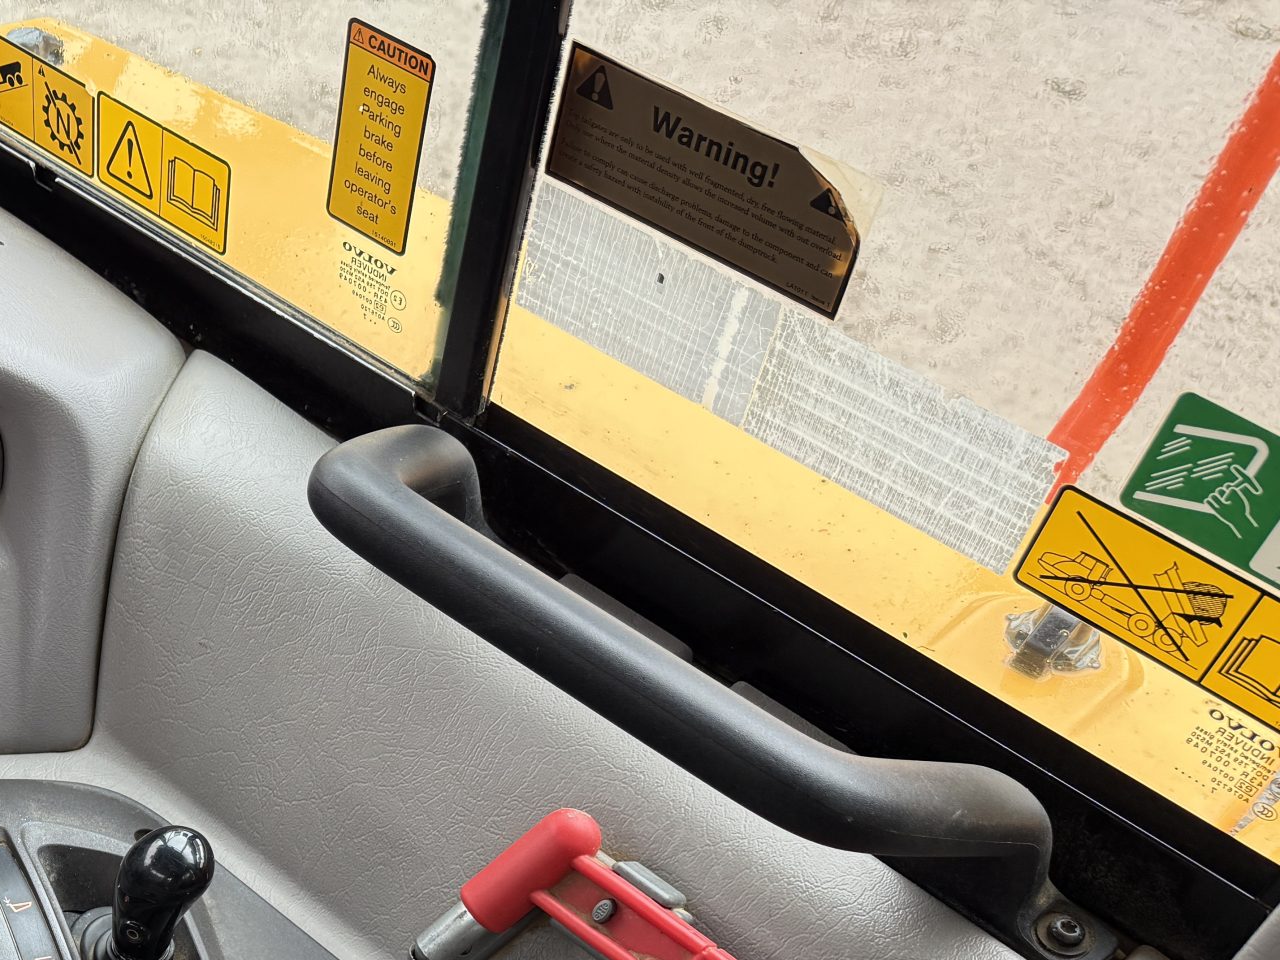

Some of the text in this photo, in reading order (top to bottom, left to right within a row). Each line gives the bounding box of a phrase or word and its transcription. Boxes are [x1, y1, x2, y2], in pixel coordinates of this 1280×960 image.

[368, 34, 429, 76] CAUTION
[367, 64, 406, 94] Always
[363, 87, 405, 115] engage
[361, 103, 402, 138] Parking
[364, 125, 393, 152] brake
[653, 105, 780, 188] Warning!
[359, 144, 393, 172] before
[355, 161, 391, 195] leaving
[595, 135, 614, 150] where
[616, 145, 627, 154] the
[629, 152, 655, 169] material
[656, 165, 680, 182] density
[682, 178, 703, 192] allows
[705, 188, 716, 199] the
[718, 195, 749, 216] increased
[751, 212, 777, 228] volume
[778, 225, 795, 238] with
[797, 235, 809, 245] out
[645, 145, 654, 155] be
[655, 152, 671, 164] used
[672, 161, 687, 172] with
[689, 169, 704, 180] well
[705, 175, 745, 202] fragmented,
[761, 203, 776, 216] free
[777, 210, 805, 231] flowing
[344, 179, 397, 215] operator's
[356, 205, 379, 225] seat
[592, 155, 616, 171] comply
[617, 167, 628, 177] can
[649, 182, 680, 202] discharge
[714, 215, 740, 232] damage
[742, 228, 750, 237] to
[751, 232, 763, 243] the
[764, 241, 807, 265] component
[807, 262, 819, 272] and
[820, 269, 833, 279] can
[676, 208, 684, 217] of
[685, 212, 696, 222] the
[697, 217, 714, 232] front
[716, 229, 725, 237] of
[725, 231, 737, 242] the
